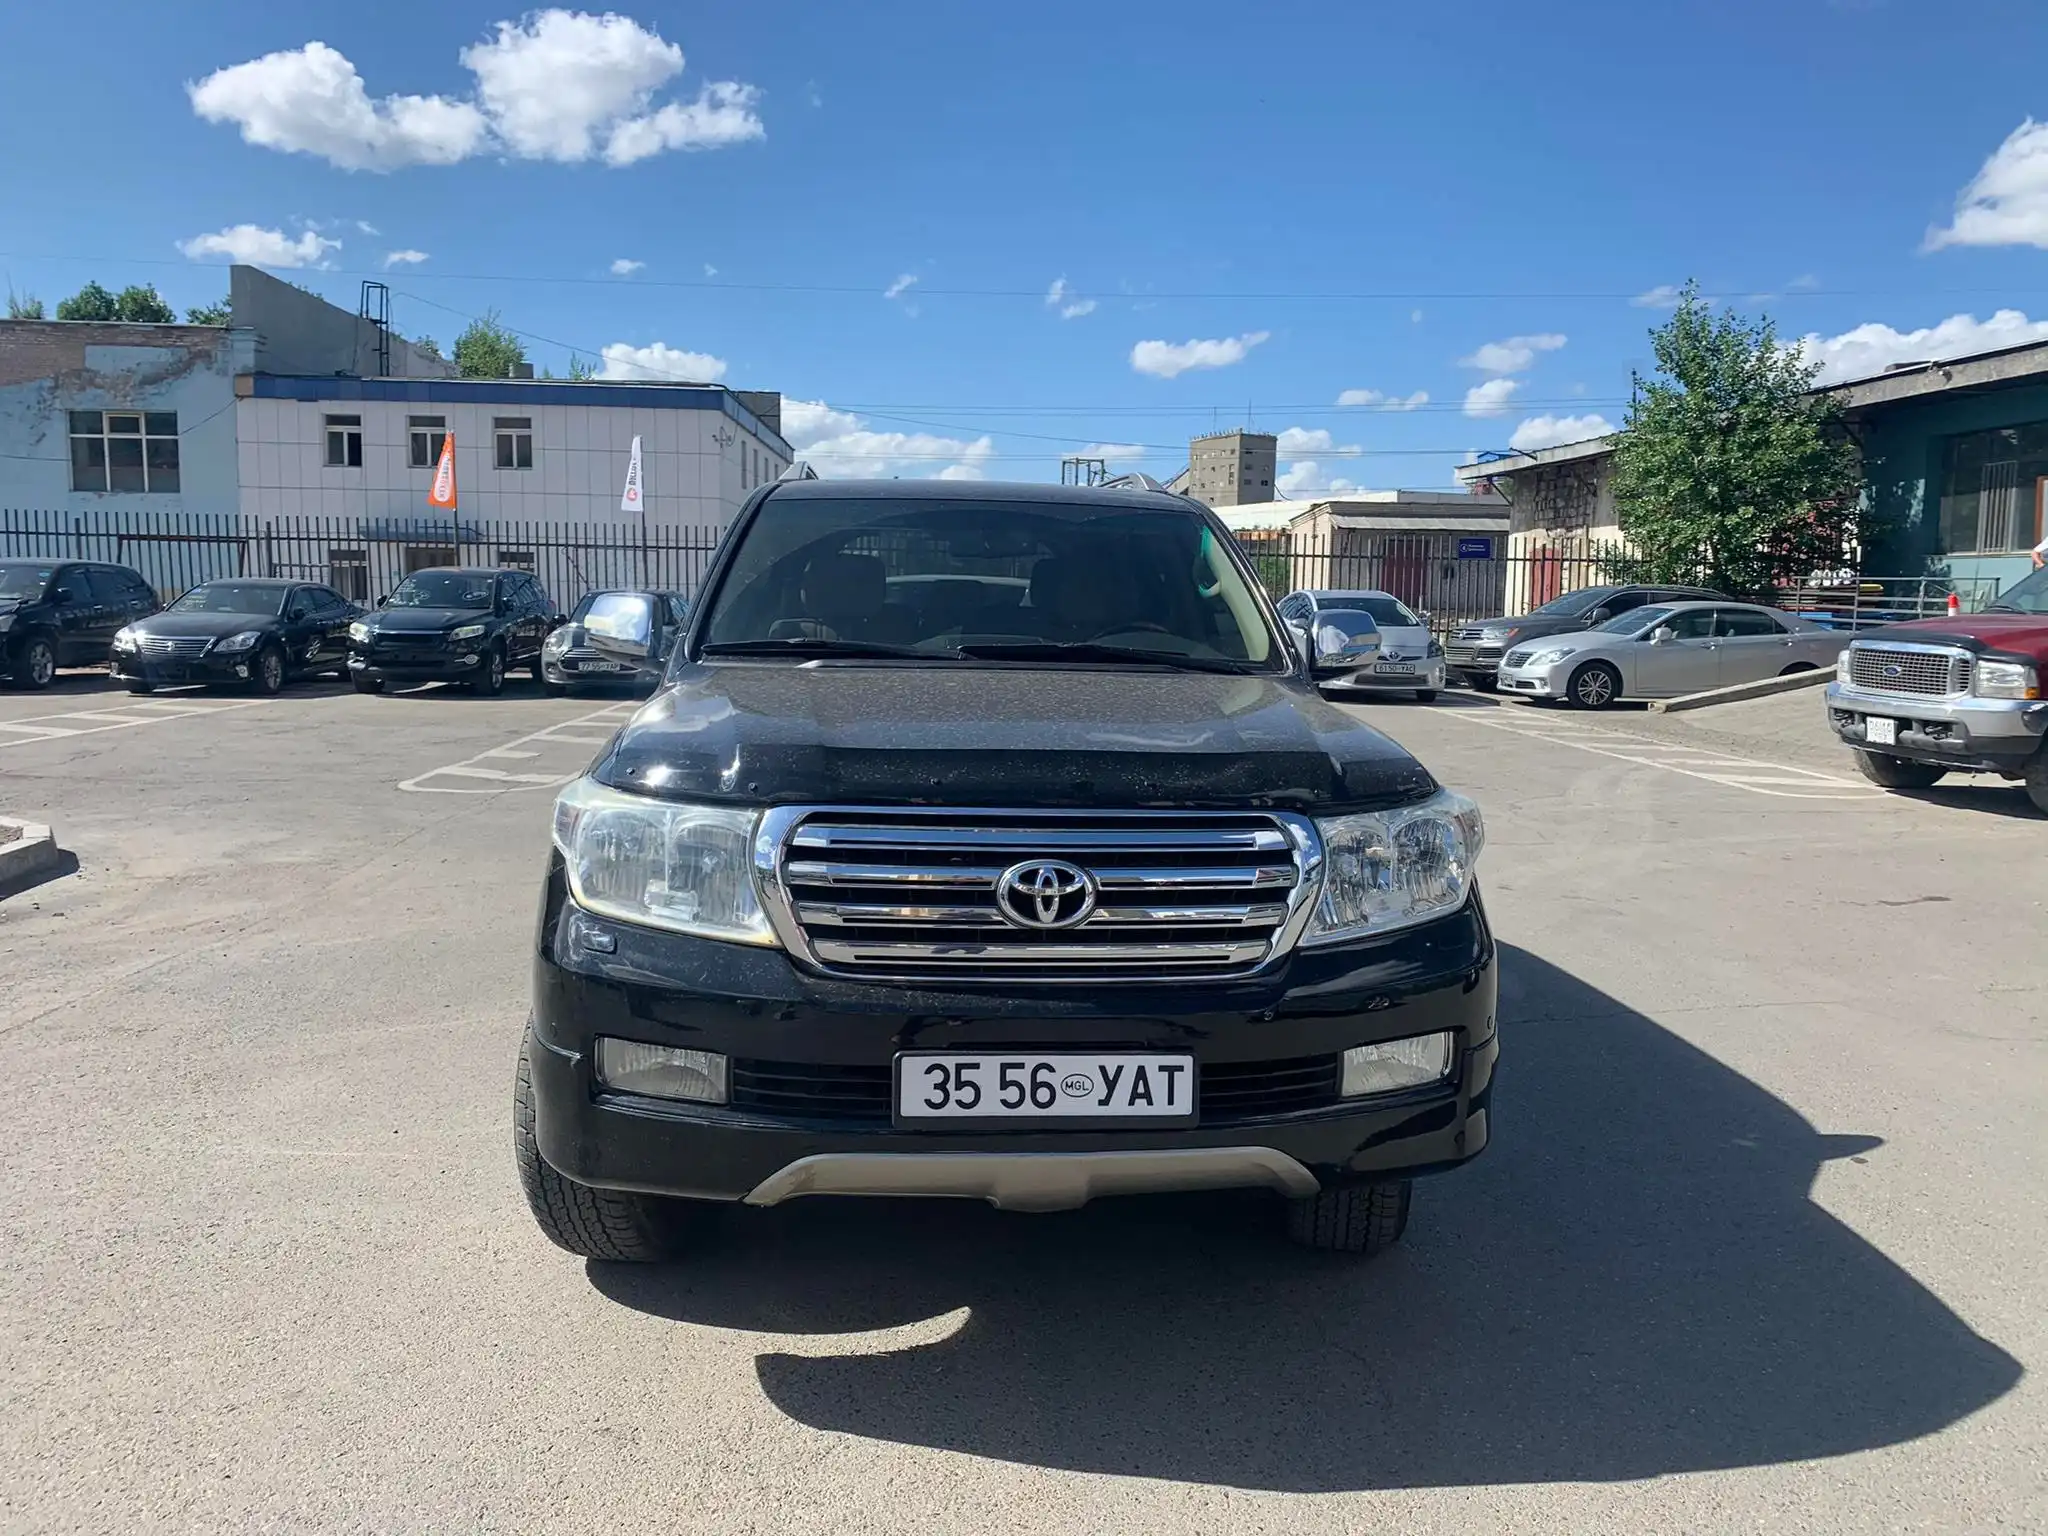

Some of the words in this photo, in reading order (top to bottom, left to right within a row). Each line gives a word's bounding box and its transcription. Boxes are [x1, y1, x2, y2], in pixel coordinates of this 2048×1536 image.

[923, 1062, 982, 1110] 35
[999, 1062, 1057, 1110] 56
[1064, 1078, 1089, 1092] MGL
